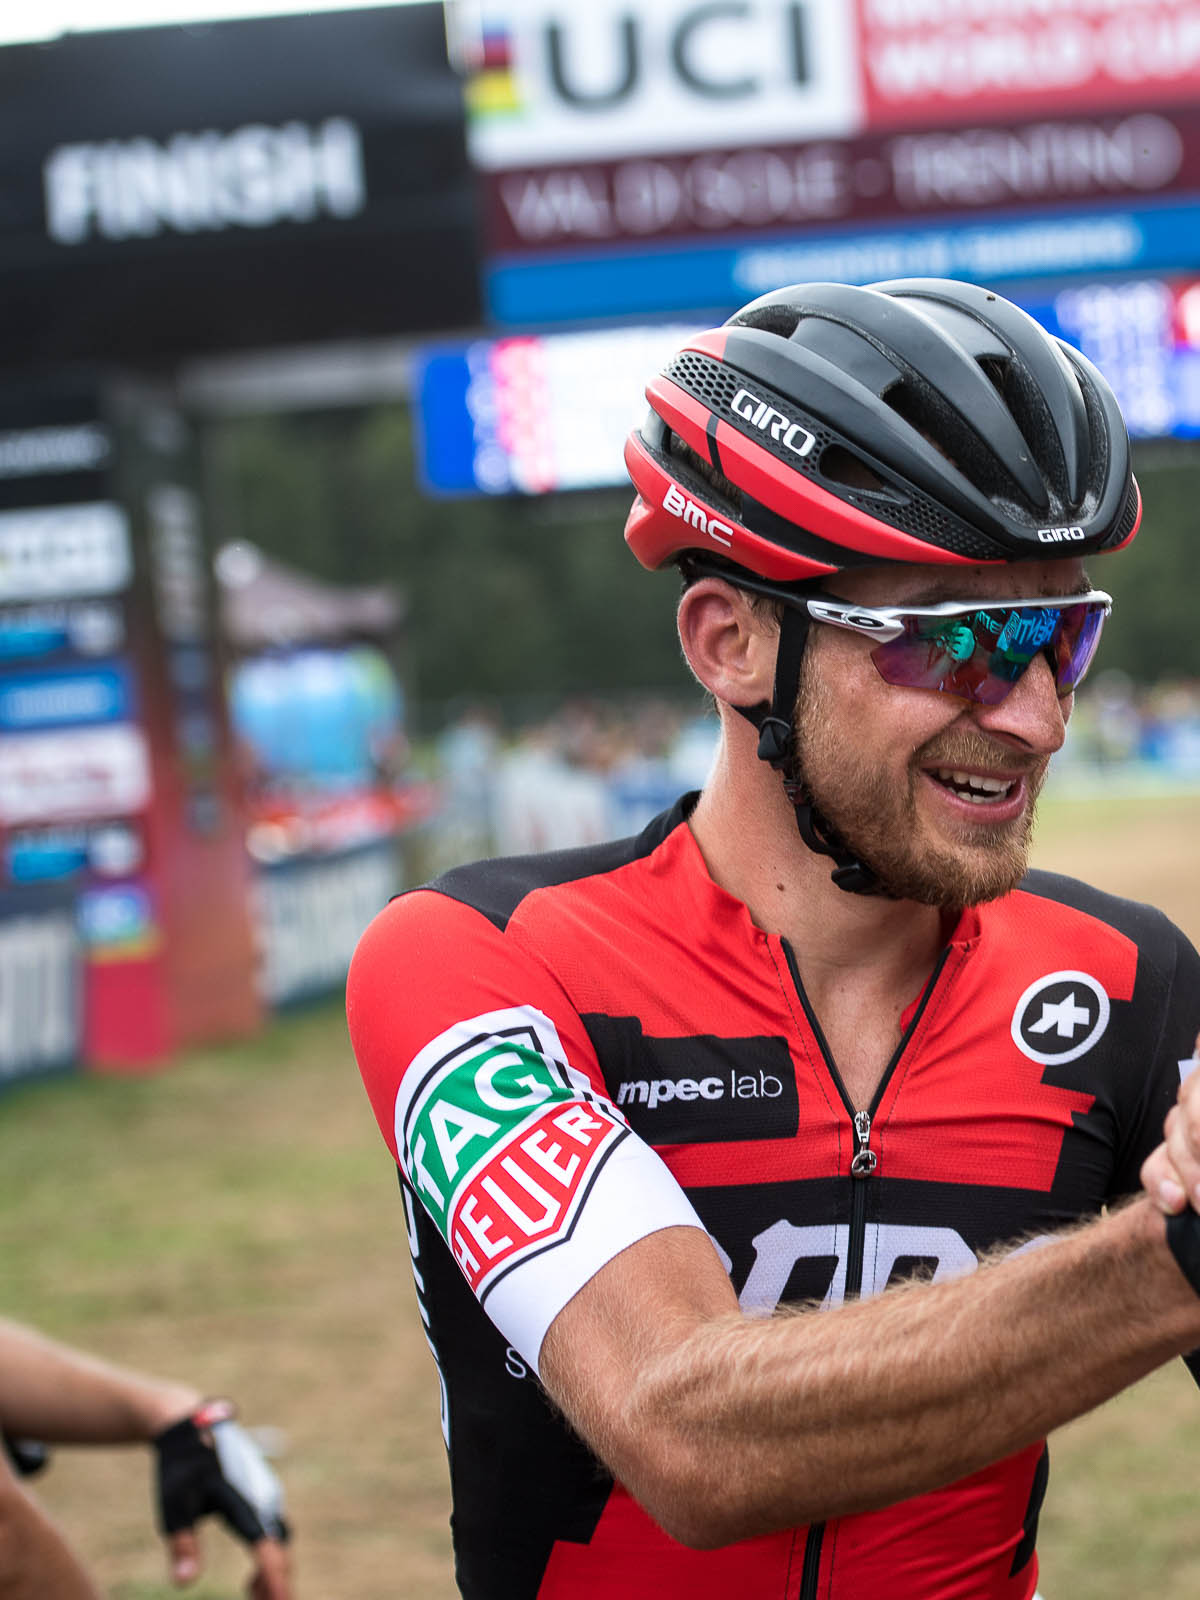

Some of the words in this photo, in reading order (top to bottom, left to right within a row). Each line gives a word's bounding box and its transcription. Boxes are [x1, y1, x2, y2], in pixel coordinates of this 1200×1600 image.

[543, 0, 812, 115] UCI
[45, 118, 362, 243] FINISH
[730, 388, 816, 457] GIRO
[661, 483, 734, 548] BMC
[1037, 526, 1085, 544] GIRO
[731, 1069, 783, 1098] lab
[413, 1051, 553, 1213] TAG
[454, 1105, 603, 1283] HEUER
